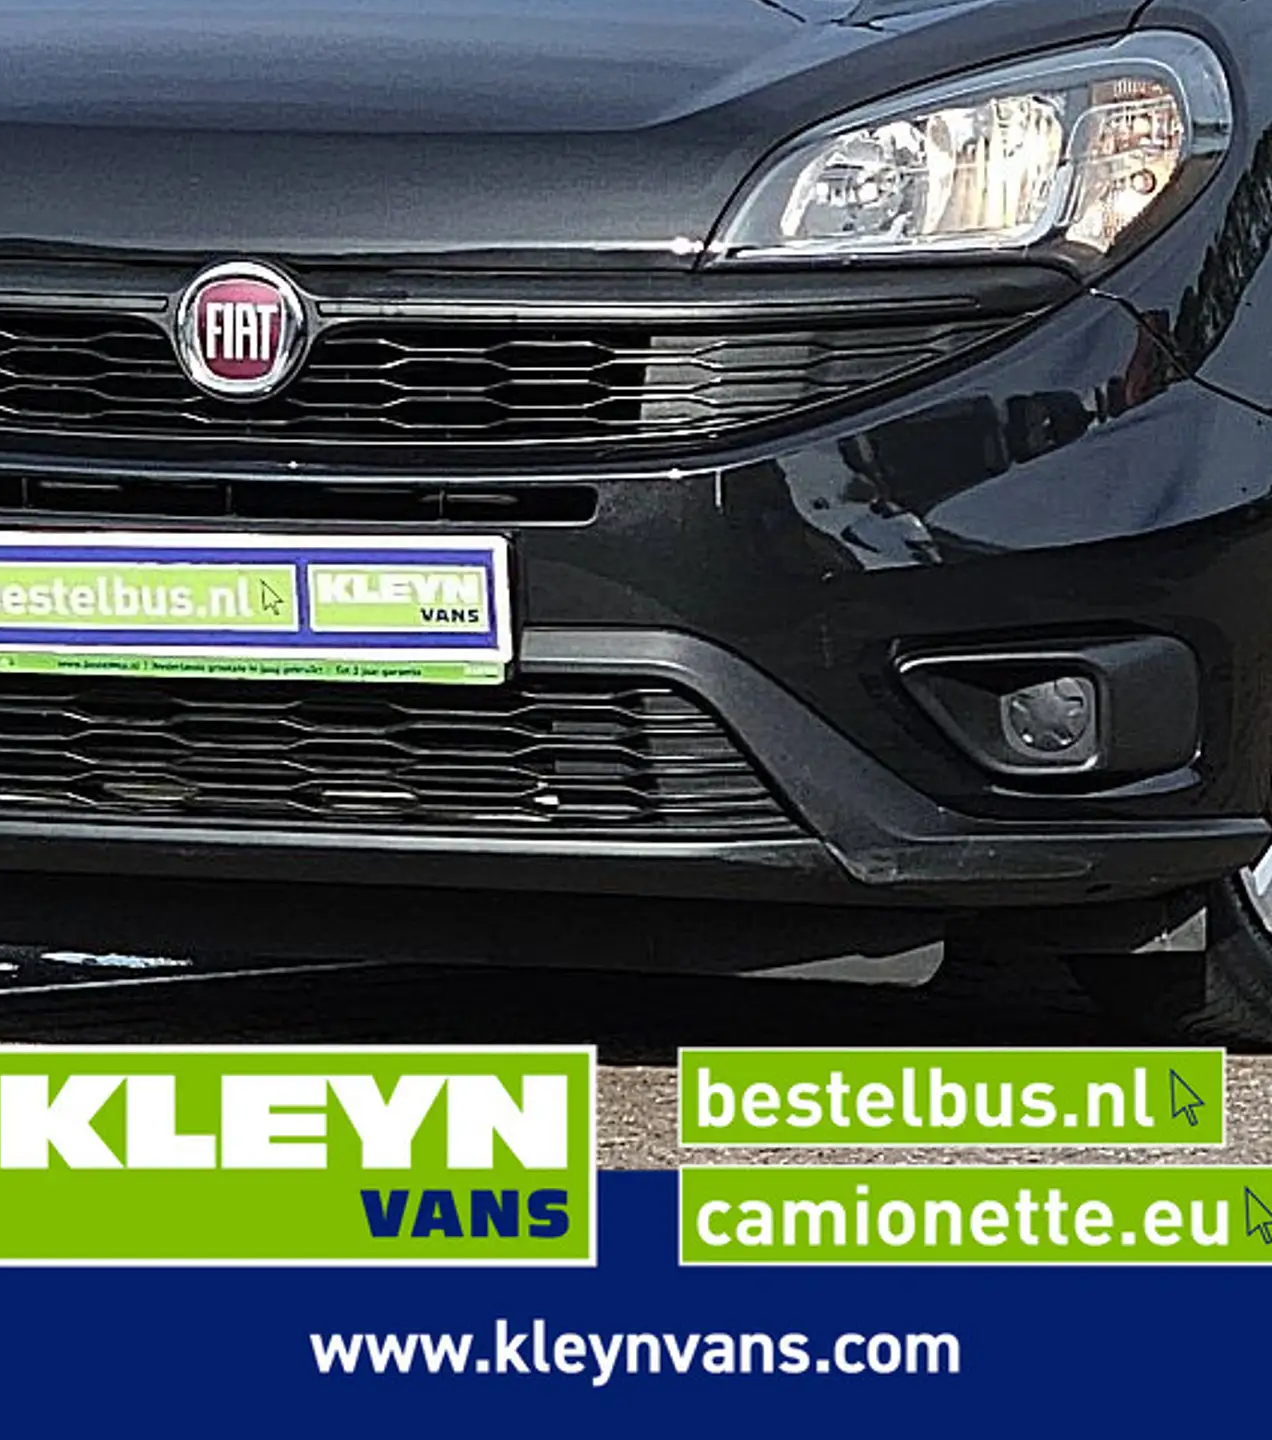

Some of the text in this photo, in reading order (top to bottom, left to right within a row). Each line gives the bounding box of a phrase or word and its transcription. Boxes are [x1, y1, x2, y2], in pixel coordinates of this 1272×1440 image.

[205, 301, 279, 361] FIAT
[316, 572, 481, 605] KLEYN
[420, 607, 480, 624] VANS
